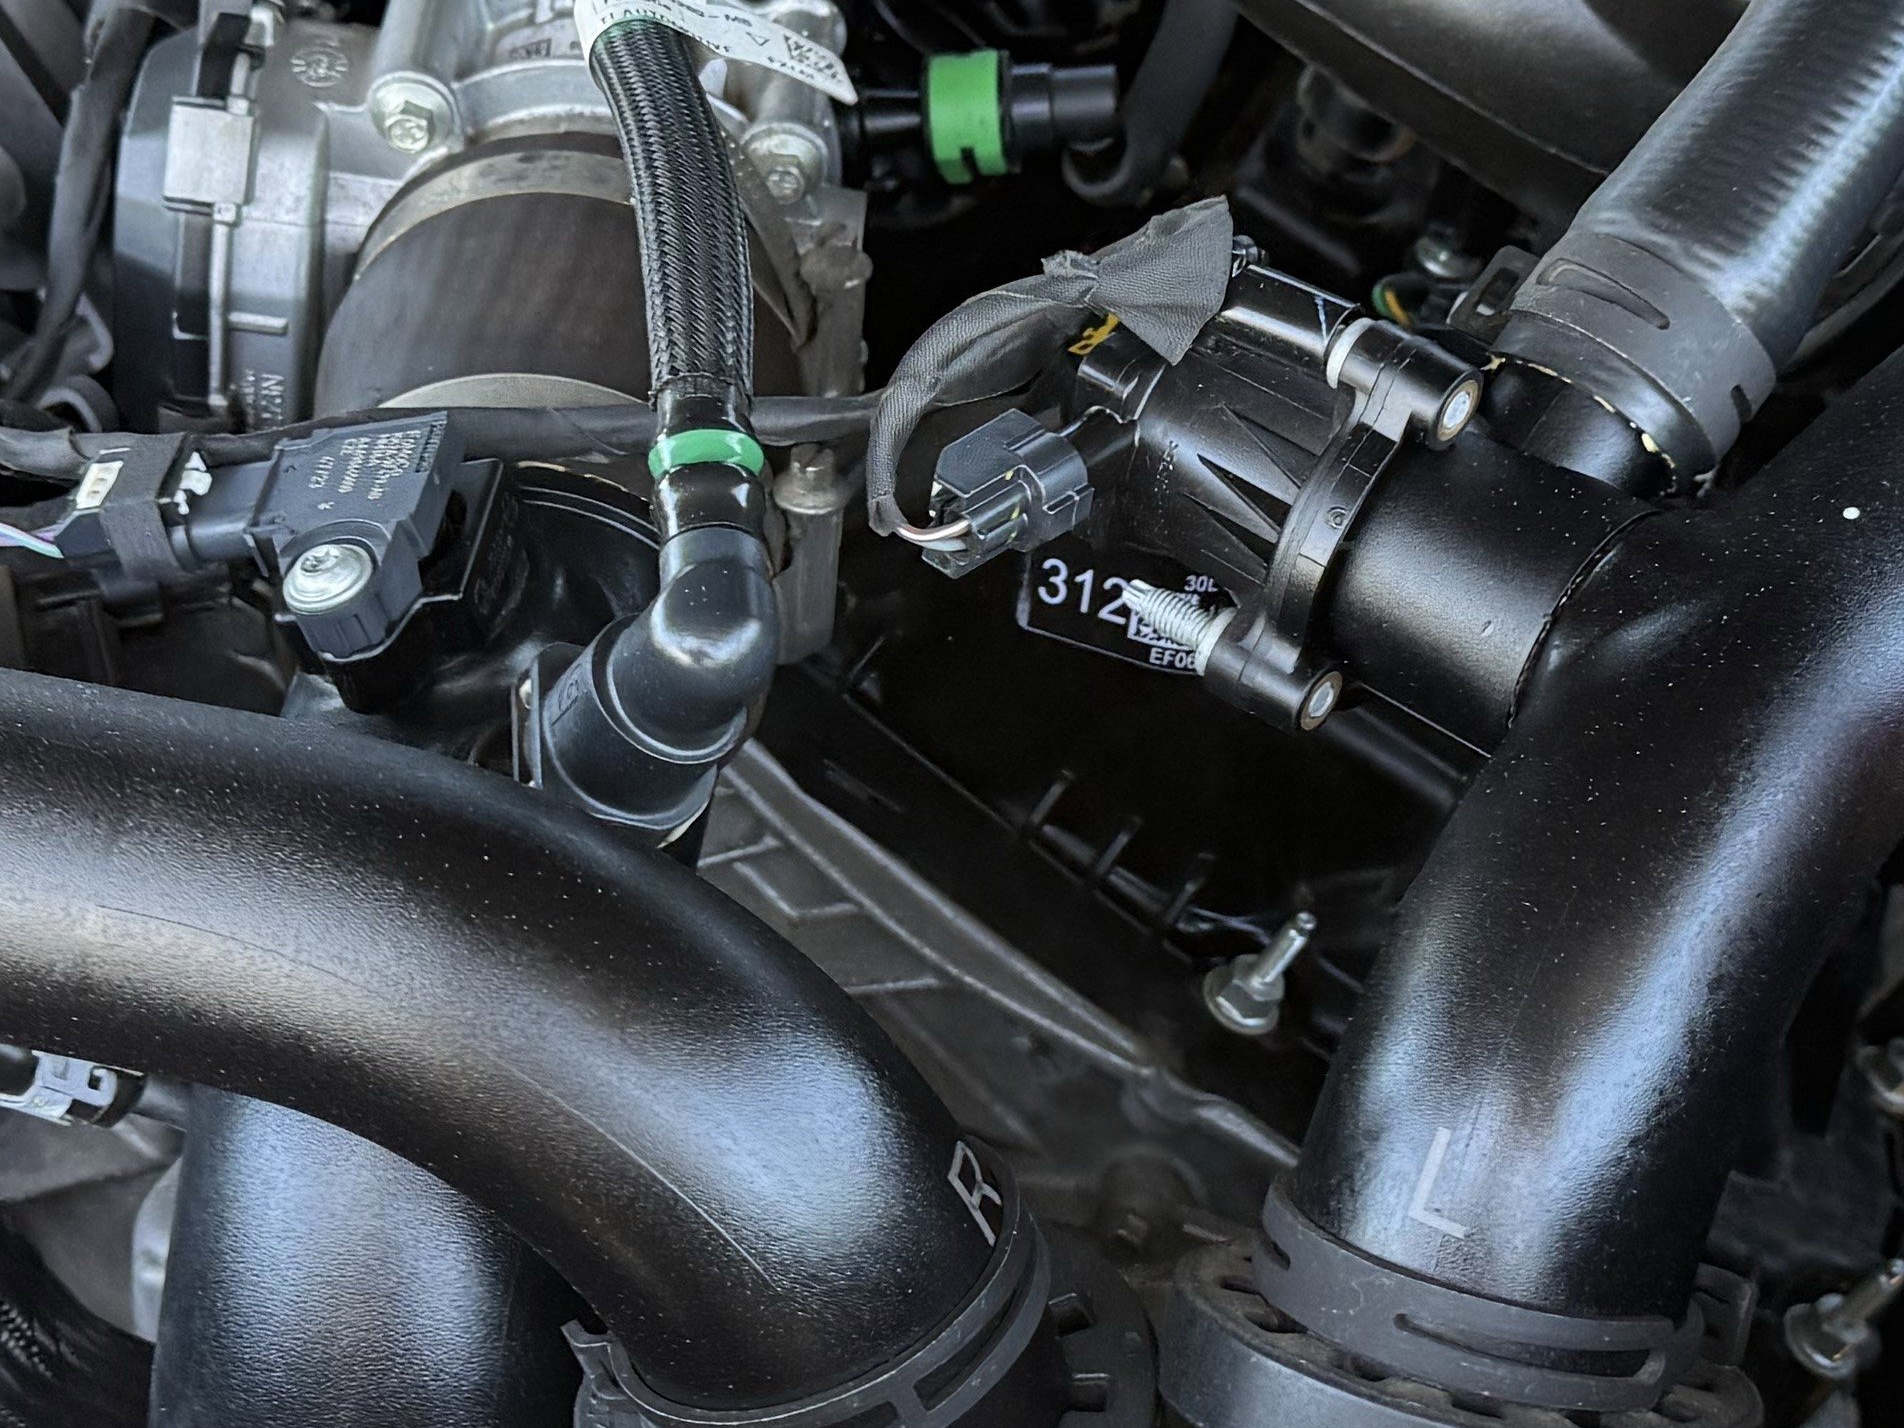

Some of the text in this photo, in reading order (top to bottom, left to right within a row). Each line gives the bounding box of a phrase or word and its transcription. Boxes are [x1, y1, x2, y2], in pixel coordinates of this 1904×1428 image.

[1038, 558, 1129, 625] 312
[948, 1140, 1002, 1247] R
[1408, 1126, 1466, 1239] L
